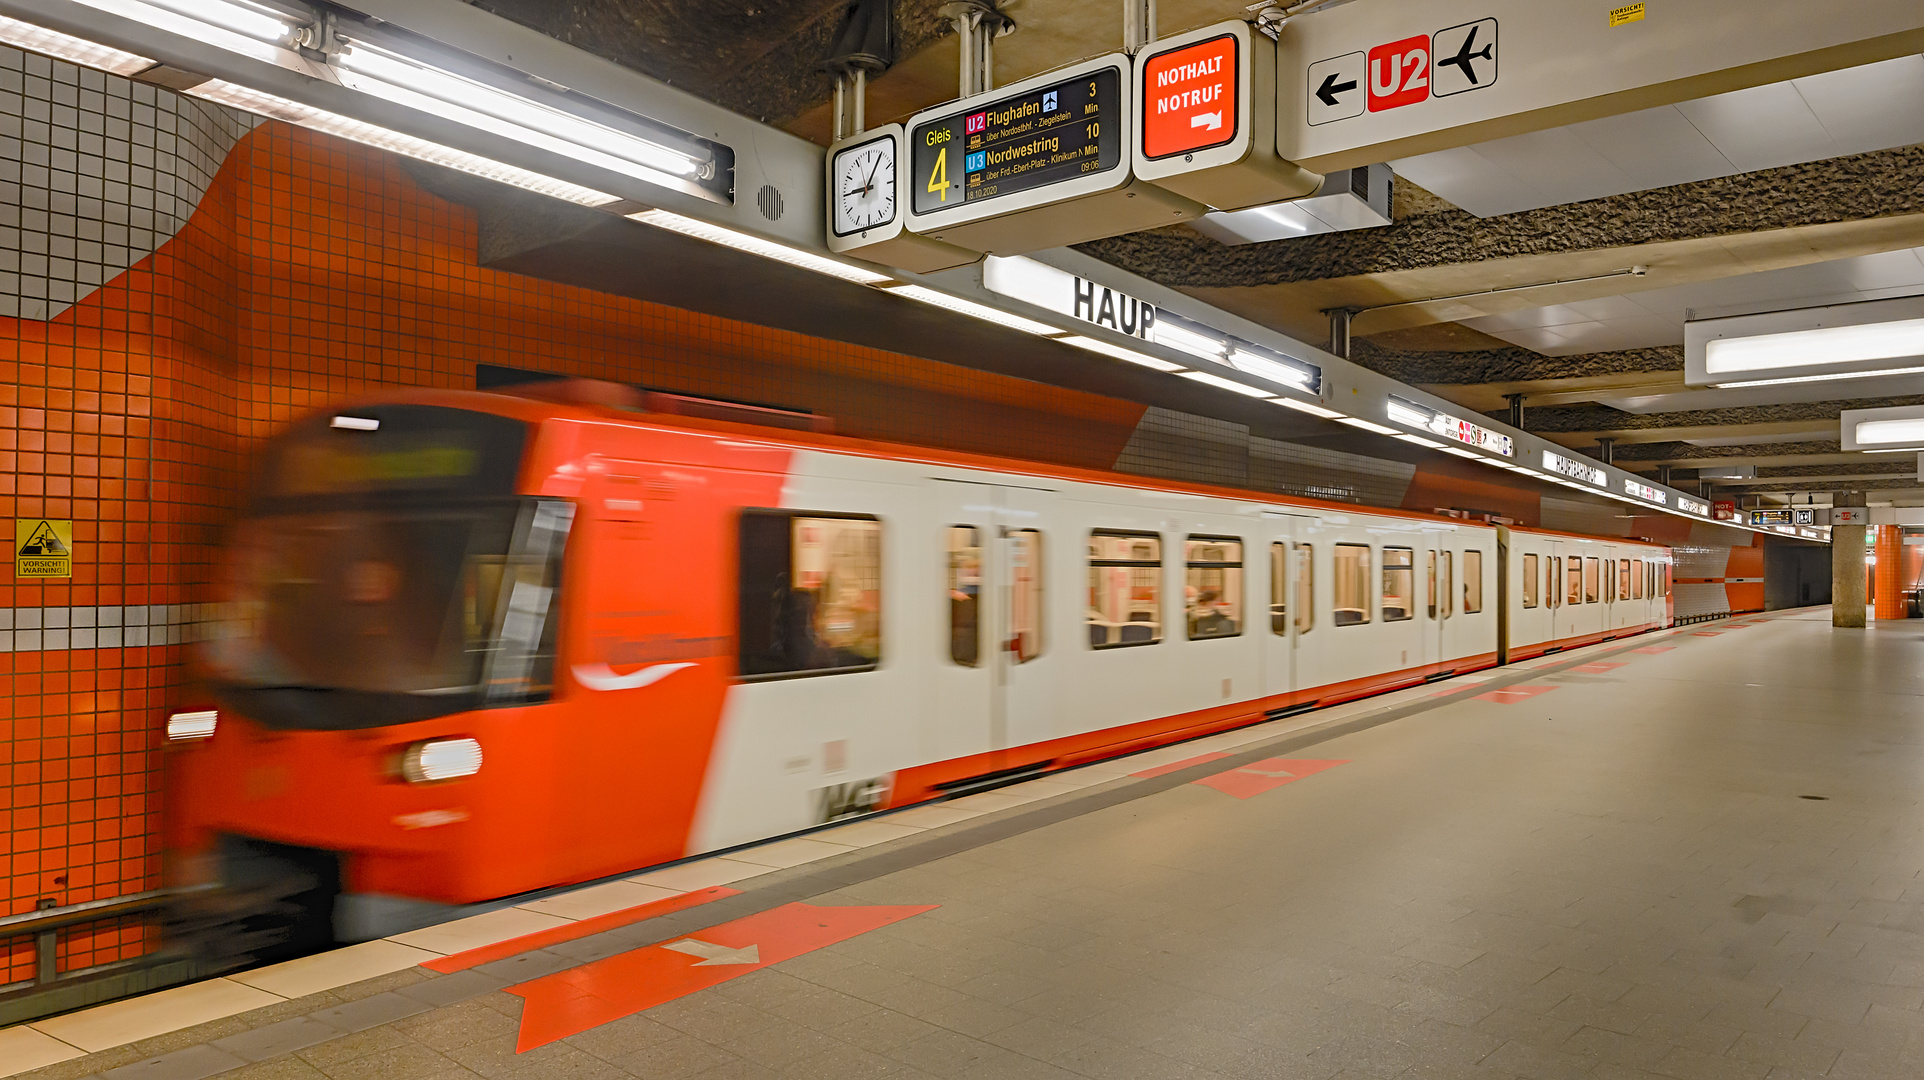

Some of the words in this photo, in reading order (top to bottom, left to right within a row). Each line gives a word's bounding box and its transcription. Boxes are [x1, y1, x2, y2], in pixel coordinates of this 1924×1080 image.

[1610, 3, 1644, 16] VORSICHT!
[1158, 55, 1223, 88] NOTHALT
[1371, 48, 1428, 98] U2
[1089, 82, 1097, 97] 3
[1158, 83, 1223, 114] NOTRUF
[968, 115, 984, 132] U2
[987, 102, 1040, 127] Flughafen
[986, 131, 999, 142] über
[1000, 121, 1034, 138] Nordostbhf.
[1038, 111, 1072, 128] Ziegelstein
[1086, 122, 1100, 139] 10
[926, 128, 951, 147] Gleis
[1084, 145, 1098, 156] Min
[968, 154, 984, 170] U3
[987, 136, 1059, 166] Nordwestring
[986, 170, 999, 181] über
[1000, 160, 1046, 177] Frd.-Ebert-Platz
[1051, 150, 1078, 164] Klinikum
[1081, 160, 1099, 172] 09:06
[927, 147, 950, 202] 4
[967, 185, 998, 200] 18.10.2020
[1074, 276, 1155, 340] HAUP
[1754, 515, 1761, 524] 4
